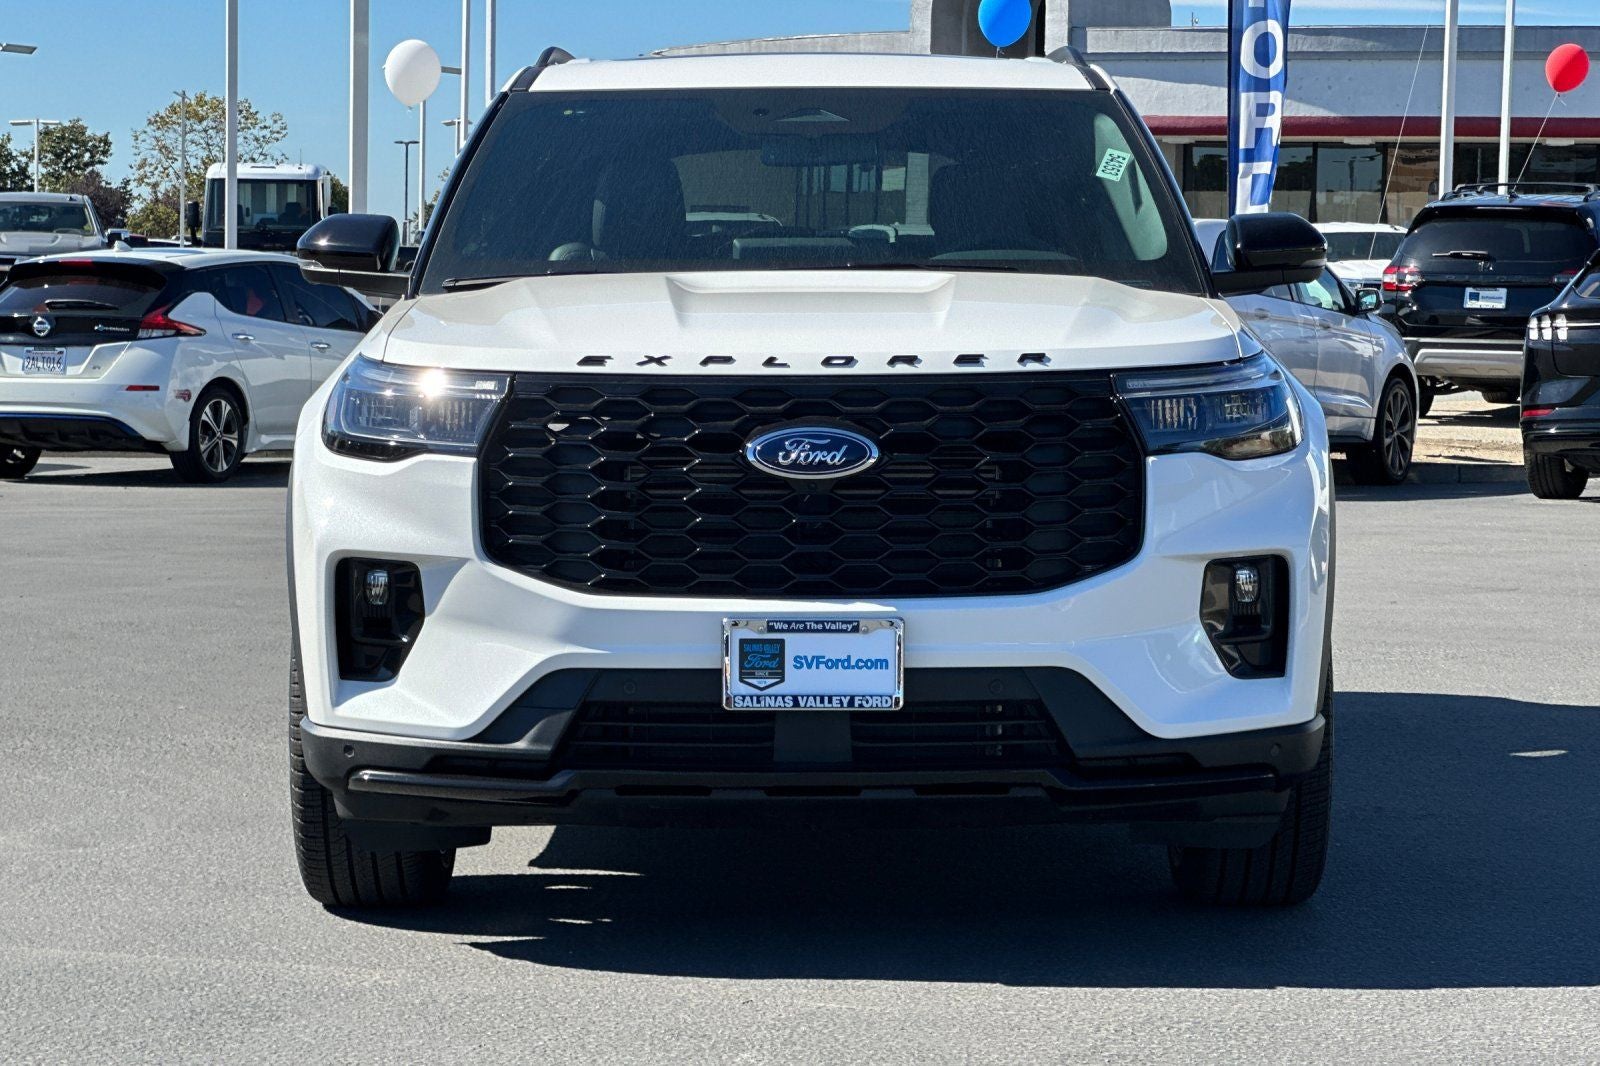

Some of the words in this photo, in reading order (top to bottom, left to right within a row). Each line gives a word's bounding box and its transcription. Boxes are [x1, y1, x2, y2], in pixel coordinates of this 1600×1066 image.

[576, 353, 1051, 368] EXPLORER
[778, 438, 849, 466] Ford
[789, 621, 805, 630] Are
[805, 621, 823, 630] The
[744, 653, 780, 668] Ford
[792, 655, 889, 670] SVFord.com
[734, 696, 794, 708] SALINAS
[799, 696, 849, 708] VALLEY
[854, 696, 892, 708] FORD
